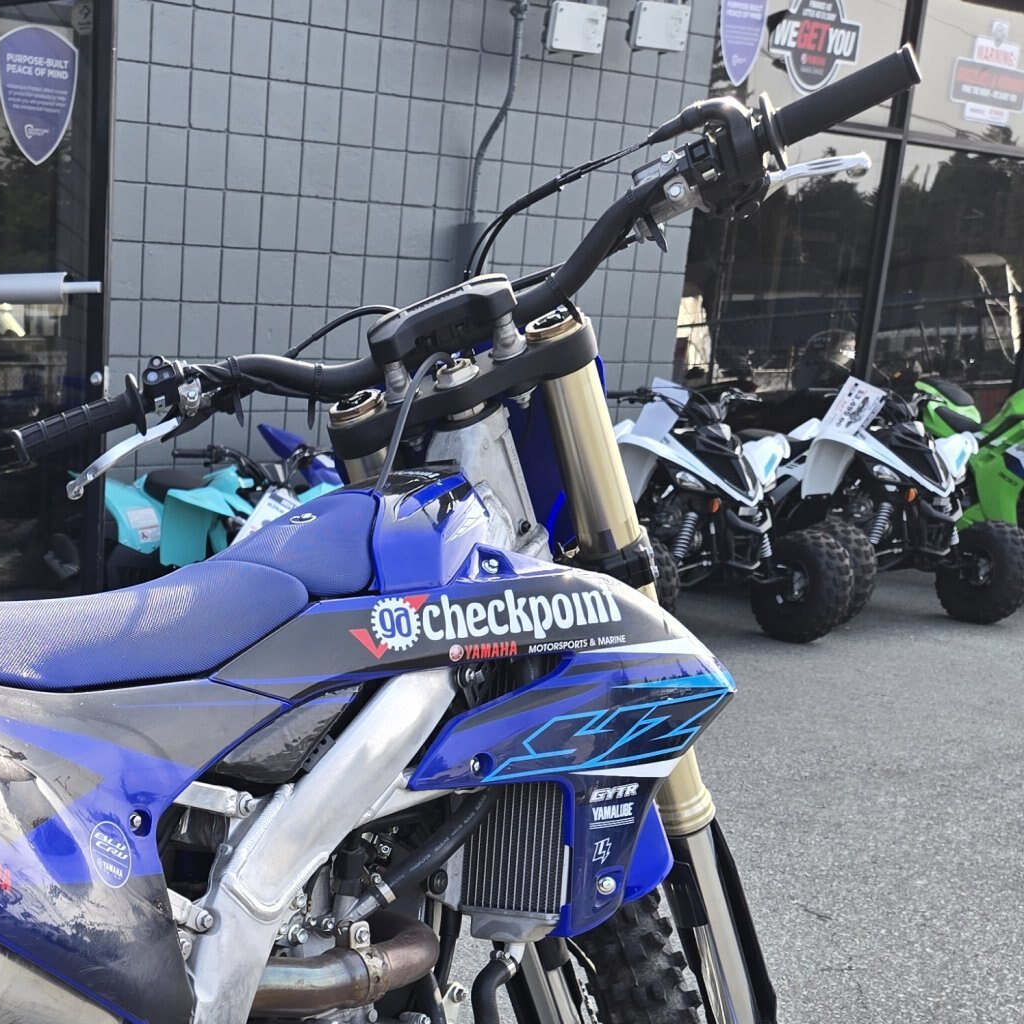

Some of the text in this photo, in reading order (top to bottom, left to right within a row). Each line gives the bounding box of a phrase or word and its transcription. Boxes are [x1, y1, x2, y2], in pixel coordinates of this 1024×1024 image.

[774, 19, 801, 48] WE
[797, 19, 832, 52] GET
[826, 27, 857, 57] YOU
[6, 52, 70, 69] PURPOSE-BUILT
[6, 63, 69, 80] PEACE OF MIND
[422, 586, 622, 640] checkpoint
[463, 634, 626, 660] YAMAHA MOTORSPORTS & MARINE
[589, 782, 640, 803] GYTR
[592, 802, 635, 822] YAMALUBE
[94, 832, 127, 851] BLU
[95, 840, 129, 860] CRU
[102, 860, 123, 877] YAMAHA
